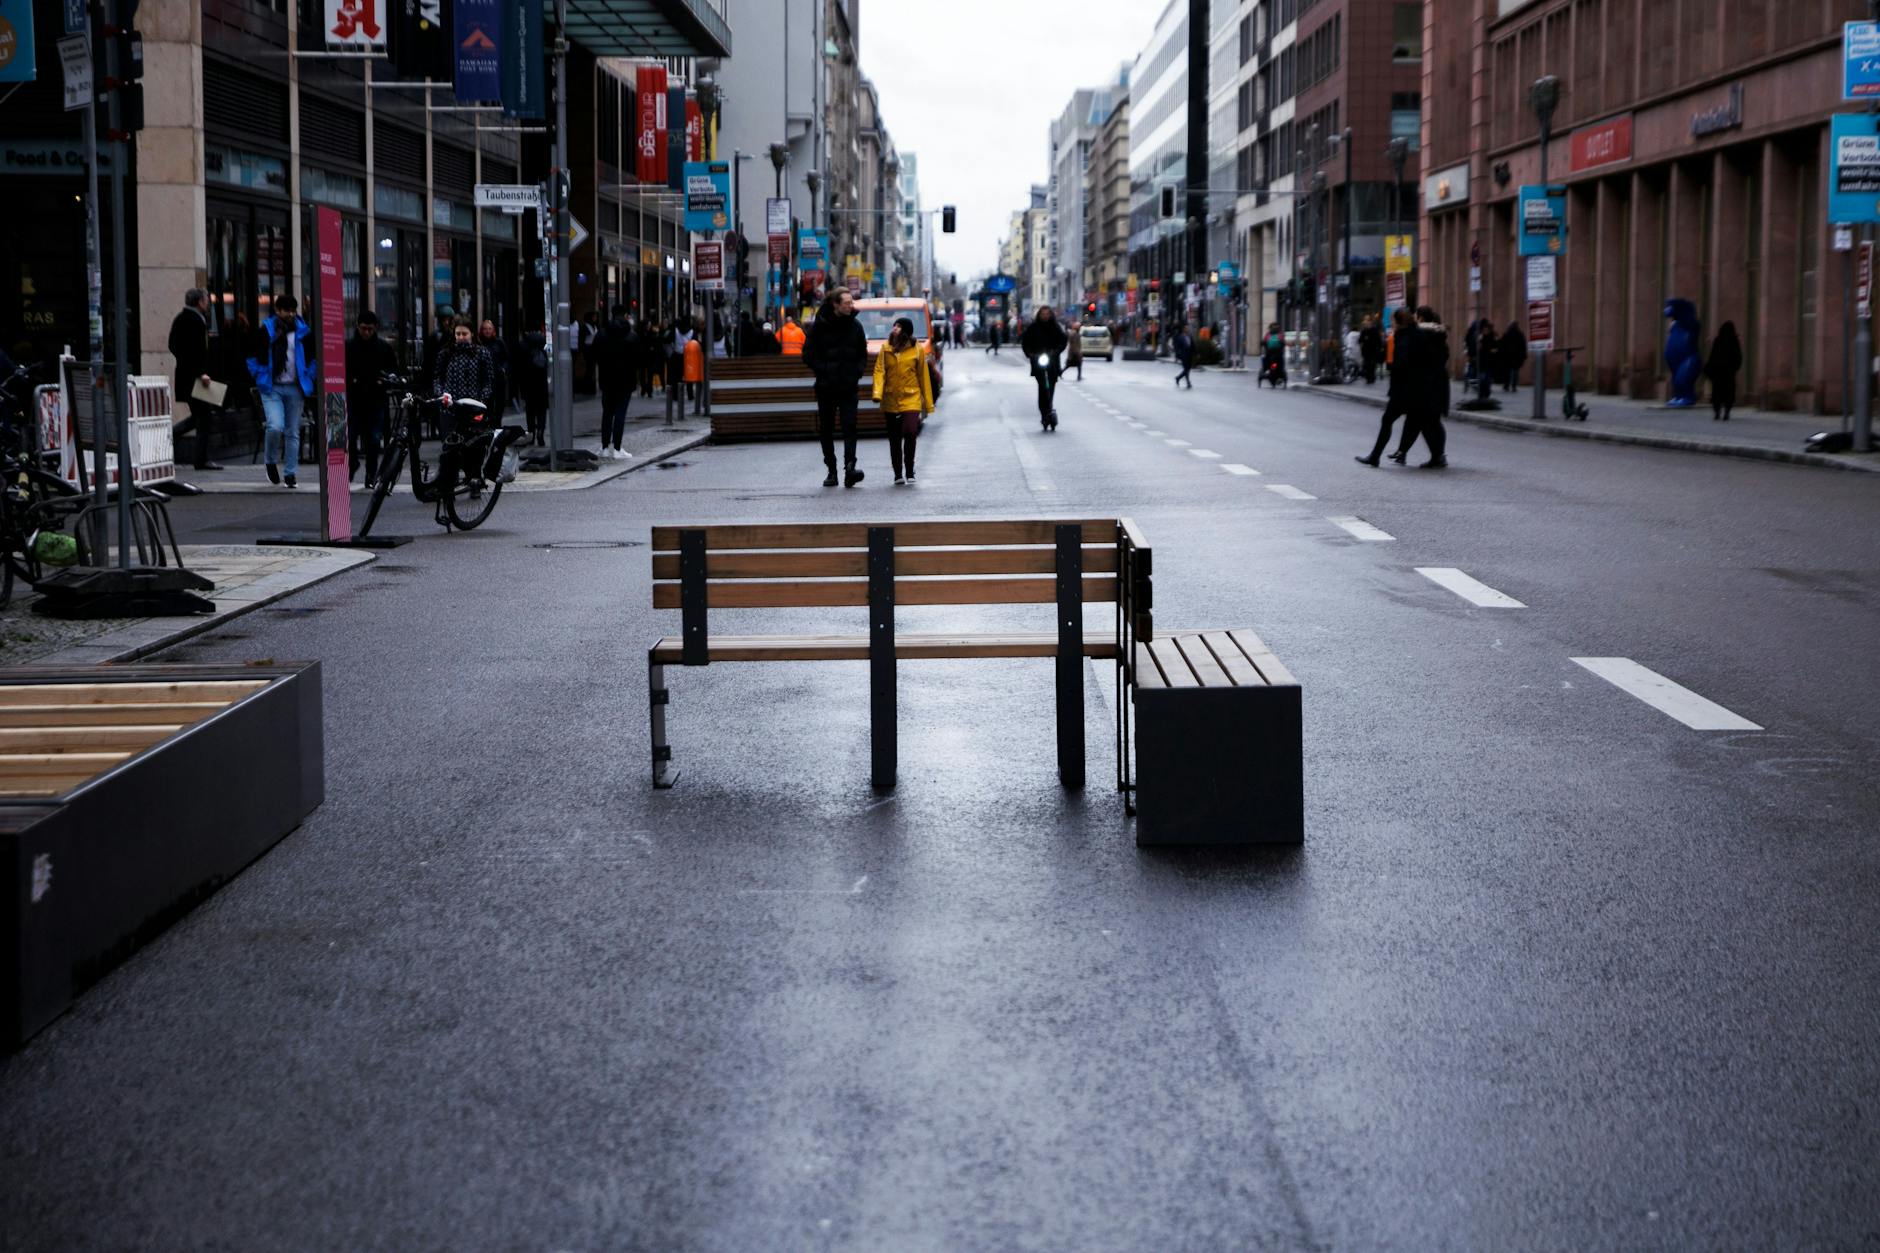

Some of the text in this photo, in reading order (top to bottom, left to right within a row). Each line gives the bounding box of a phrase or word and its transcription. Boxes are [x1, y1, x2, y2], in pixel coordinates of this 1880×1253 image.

[639, 92, 656, 158] DERTOUR
[1842, 139, 1876, 149] Grüne
[7, 151, 46, 166] Food
[51, 151, 62, 166] &
